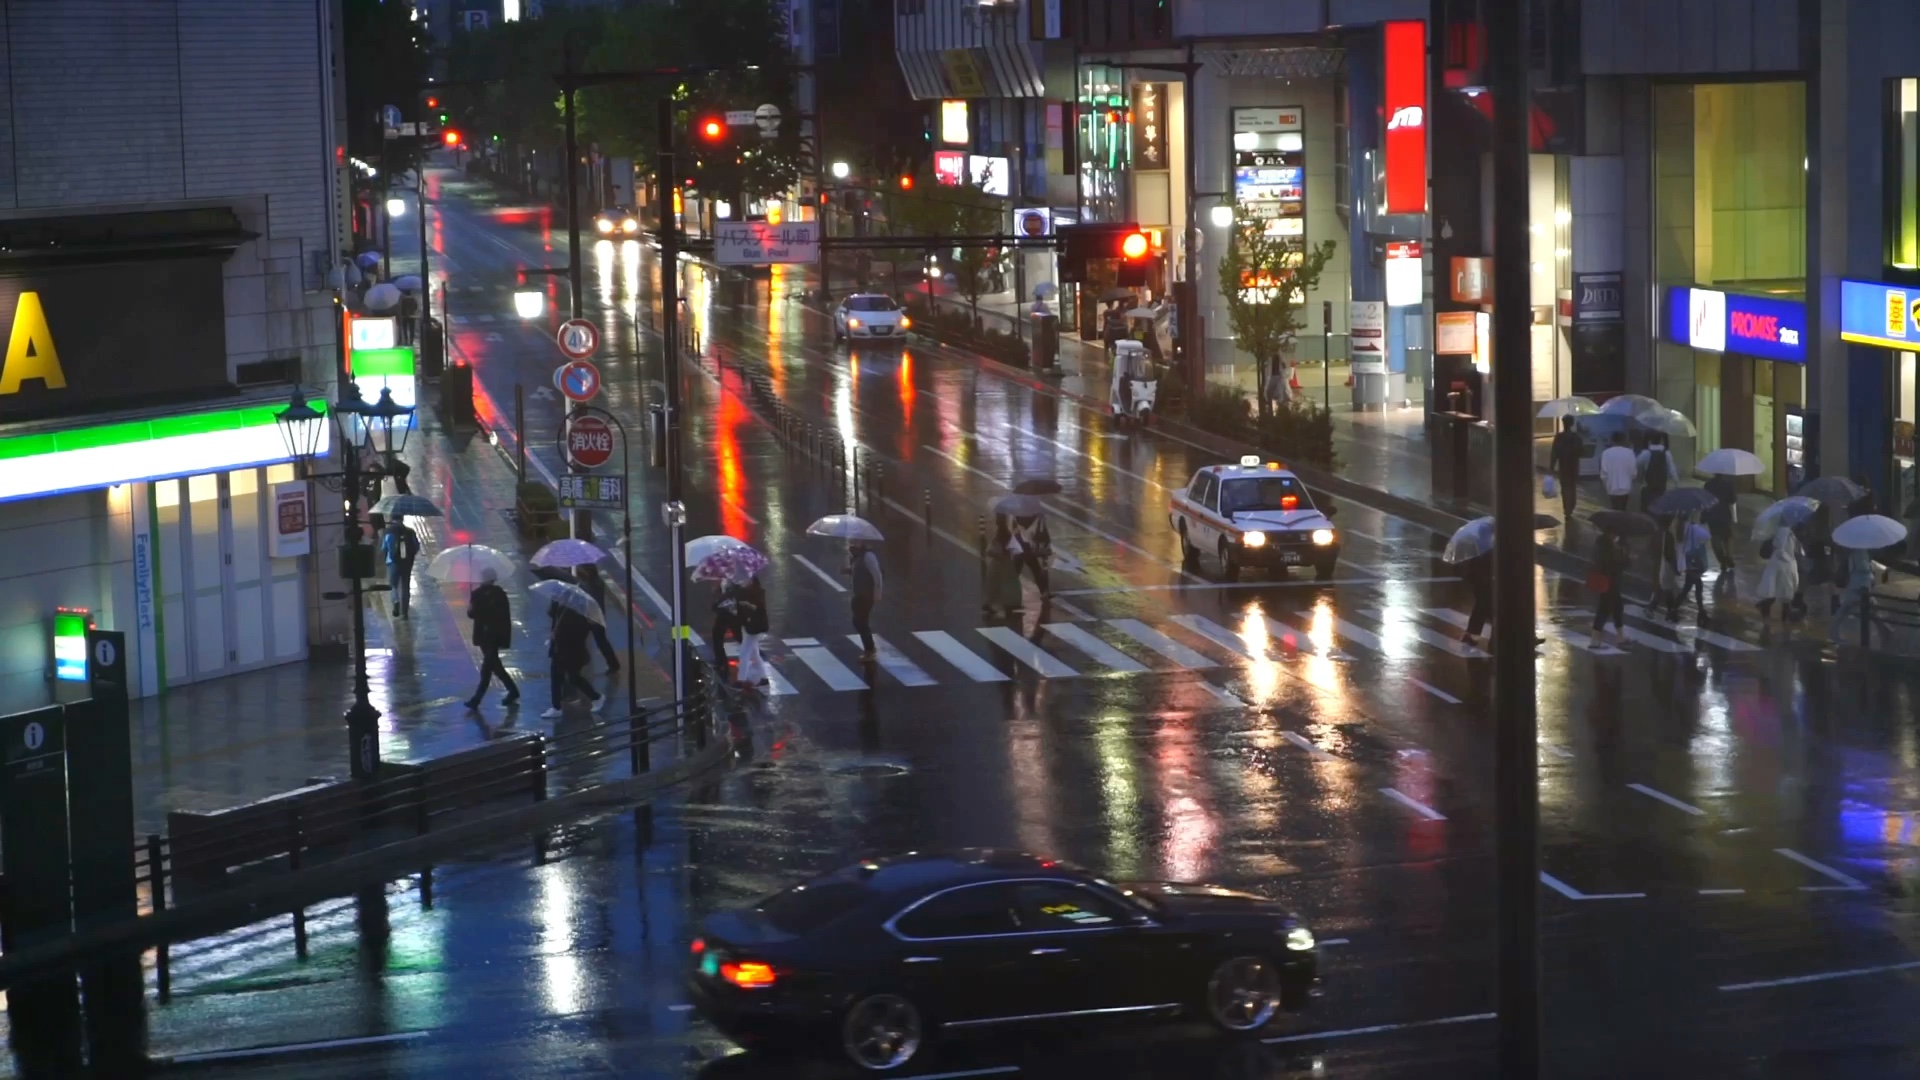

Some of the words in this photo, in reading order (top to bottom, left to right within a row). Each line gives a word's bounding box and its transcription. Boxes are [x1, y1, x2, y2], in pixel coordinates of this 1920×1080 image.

[1387, 106, 1423, 130] JTB
[1731, 311, 1779, 342] PROMISE
[1889, 296, 1904, 332] 薬
[0, 291, 67, 395] A
[571, 431, 610, 451] 消火栓
[137, 533, 151, 629] FamilyMart
